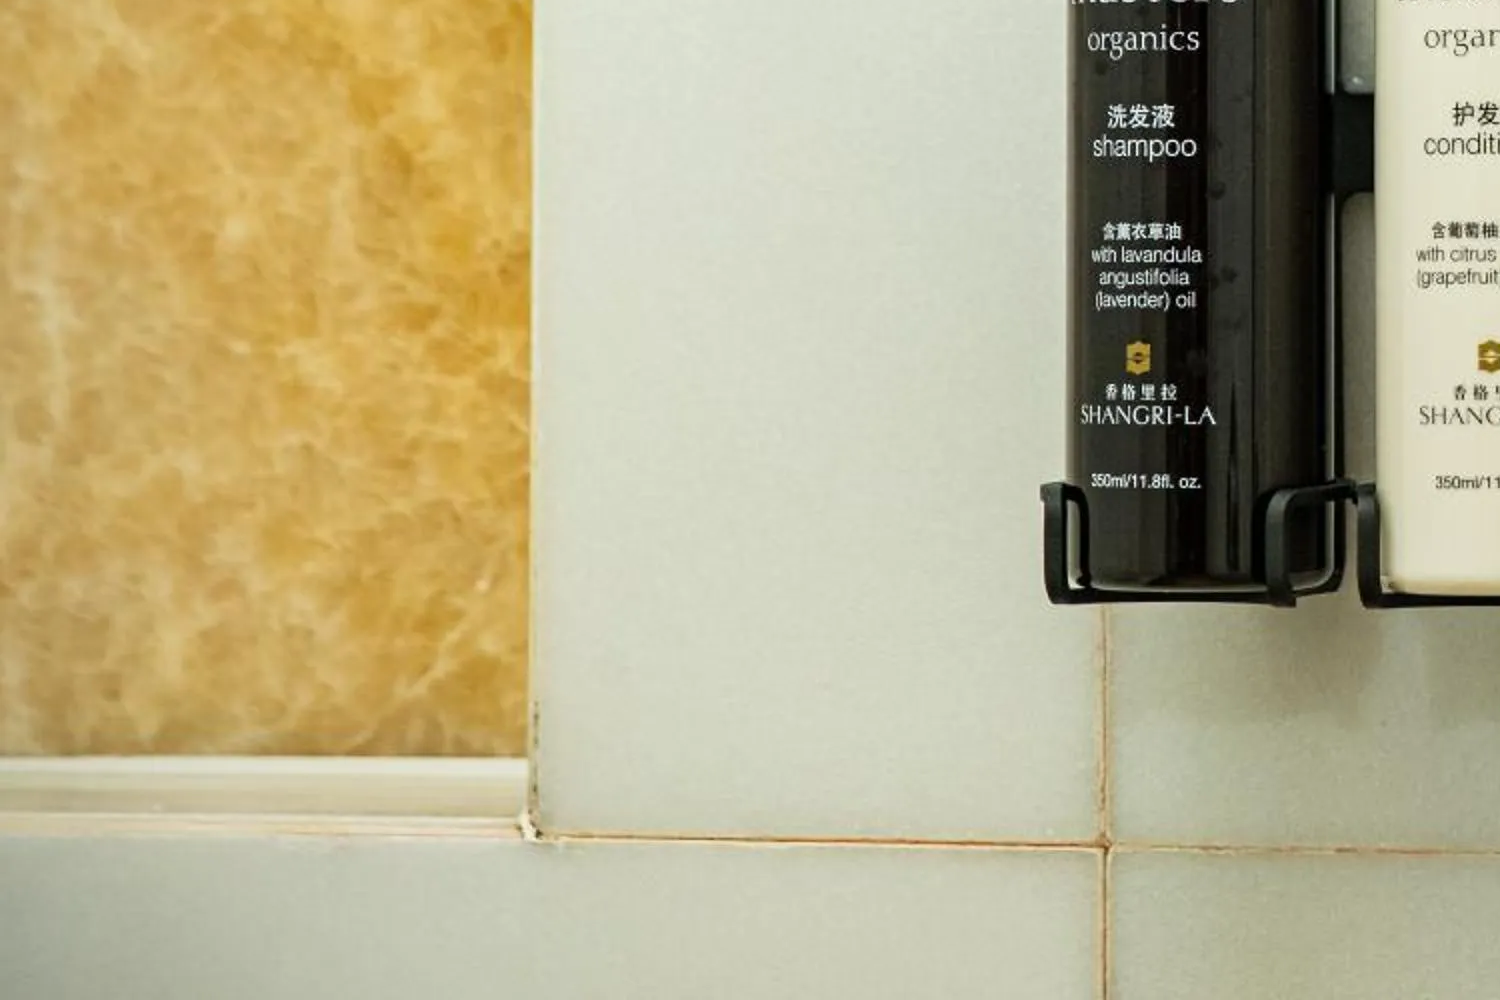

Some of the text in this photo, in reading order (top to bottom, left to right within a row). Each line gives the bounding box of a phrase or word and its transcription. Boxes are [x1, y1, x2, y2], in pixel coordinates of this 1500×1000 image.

[1087, 23, 1200, 60] organics
[1107, 103, 1176, 129] 洗发液
[1093, 134, 1197, 162] shampoo
[1091, 246, 1202, 263] with lavandula
[1416, 246, 1445, 262] with
[1450, 246, 1497, 262] citrus
[1099, 268, 1190, 289] angustifolia
[1095, 291, 1197, 311] (lavender) oil
[1105, 384, 1177, 401] 香格里拉
[1080, 405, 1217, 425] SHANGRI-LA
